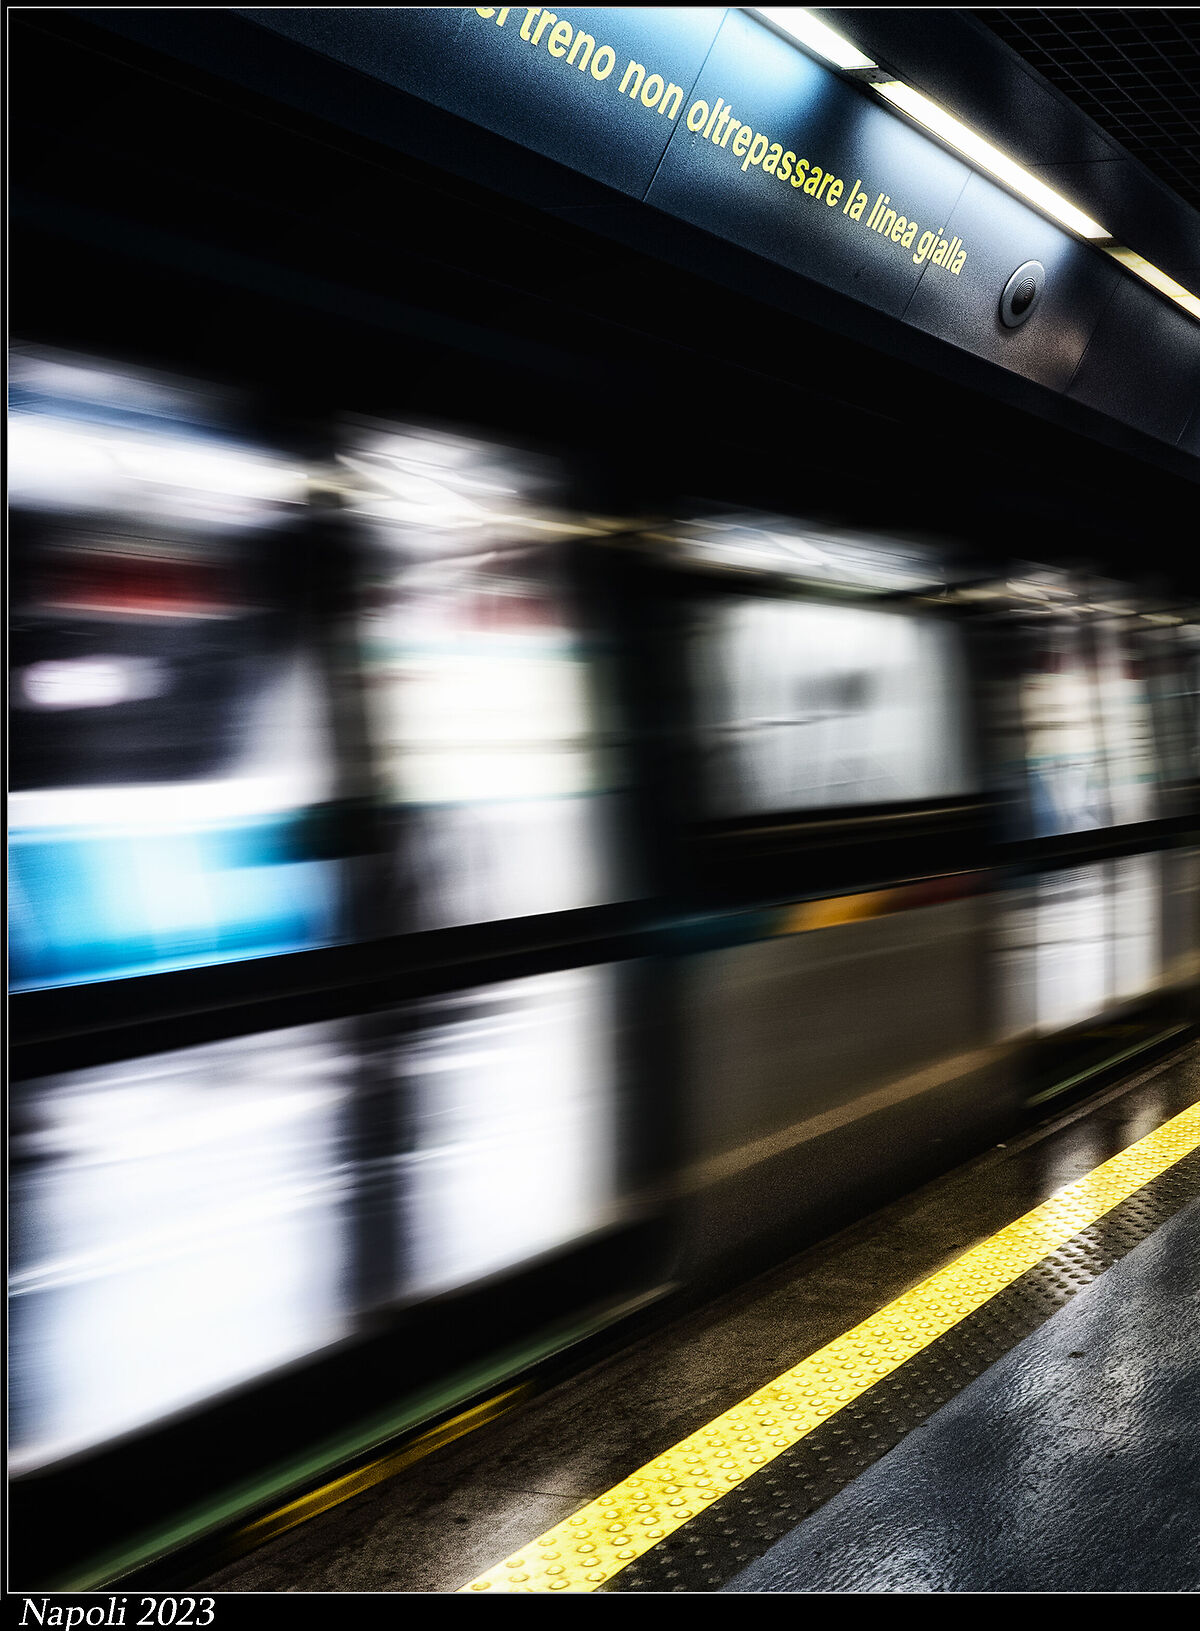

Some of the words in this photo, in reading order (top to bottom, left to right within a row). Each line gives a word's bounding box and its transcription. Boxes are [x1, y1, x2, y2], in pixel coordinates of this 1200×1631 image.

[519, 8, 616, 81] treno
[618, 60, 684, 120] non
[686, 97, 844, 207] oltrepassare
[843, 179, 868, 221] la
[866, 192, 918, 249] linea
[912, 227, 967, 275] gialla
